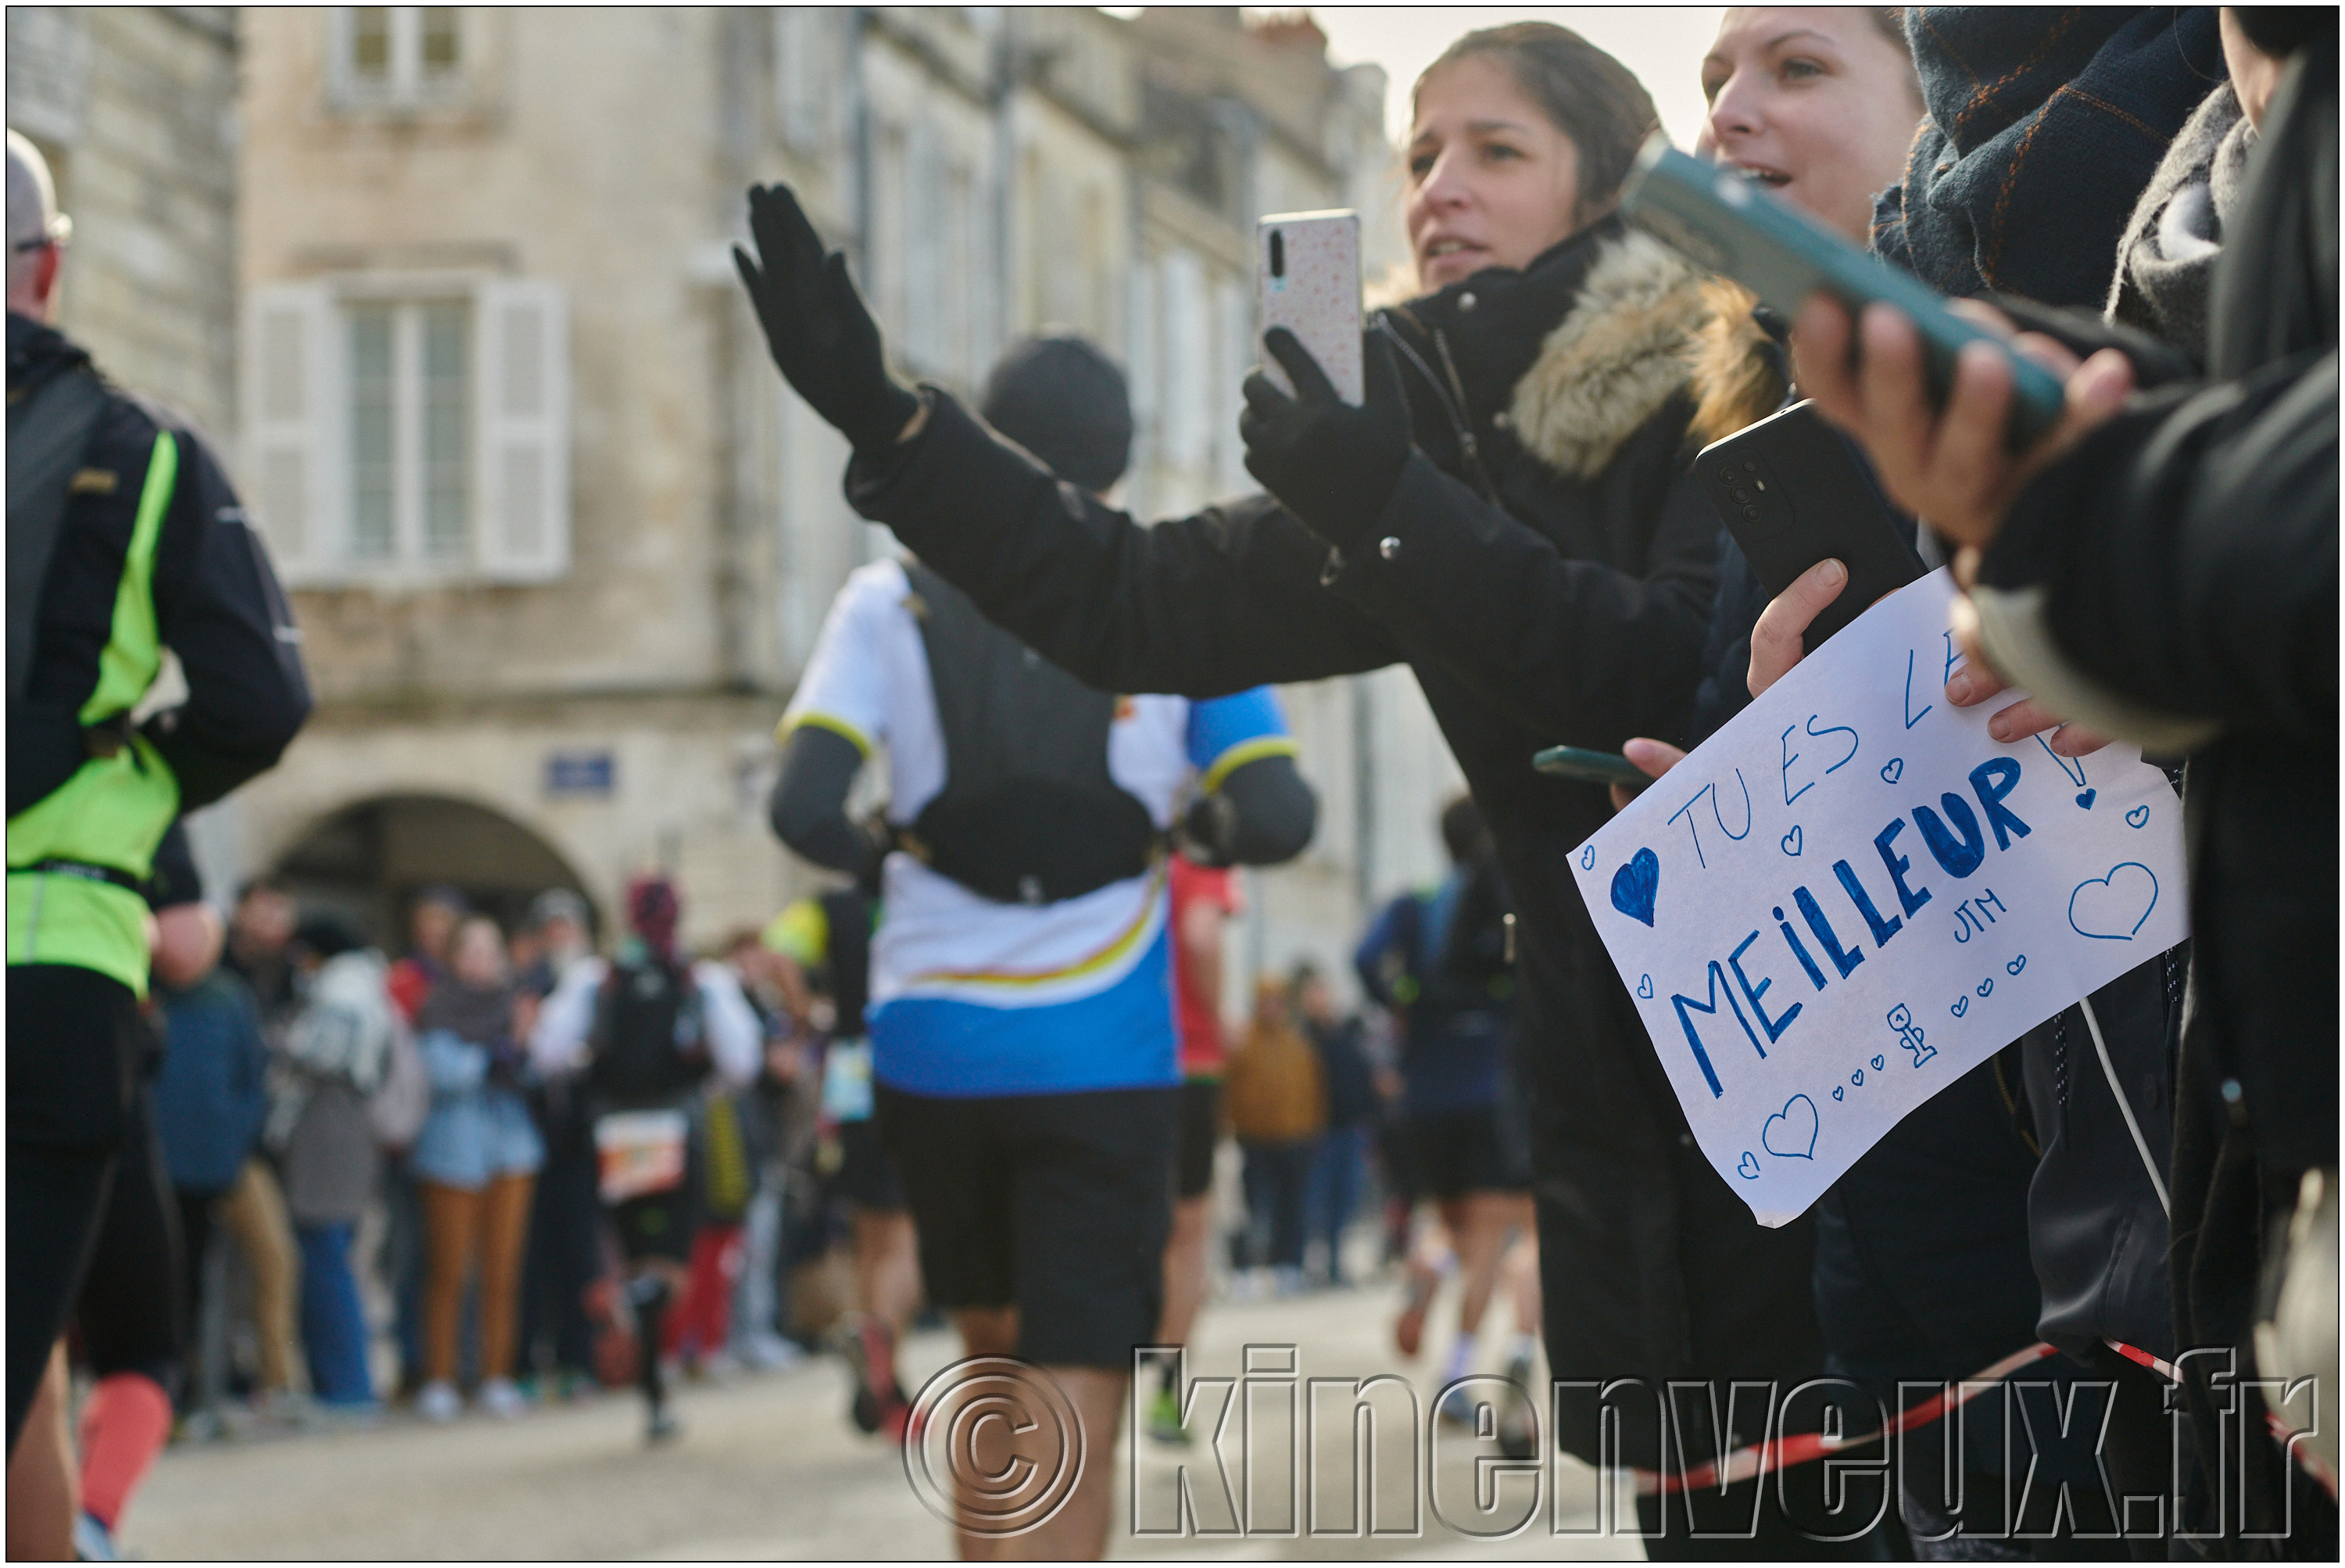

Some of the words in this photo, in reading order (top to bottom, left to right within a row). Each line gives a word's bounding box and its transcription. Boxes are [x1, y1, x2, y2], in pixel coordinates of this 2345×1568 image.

[1667, 768, 1751, 869] TU
[1781, 714, 1859, 806] ES
[1952, 888, 2008, 944] JTM
